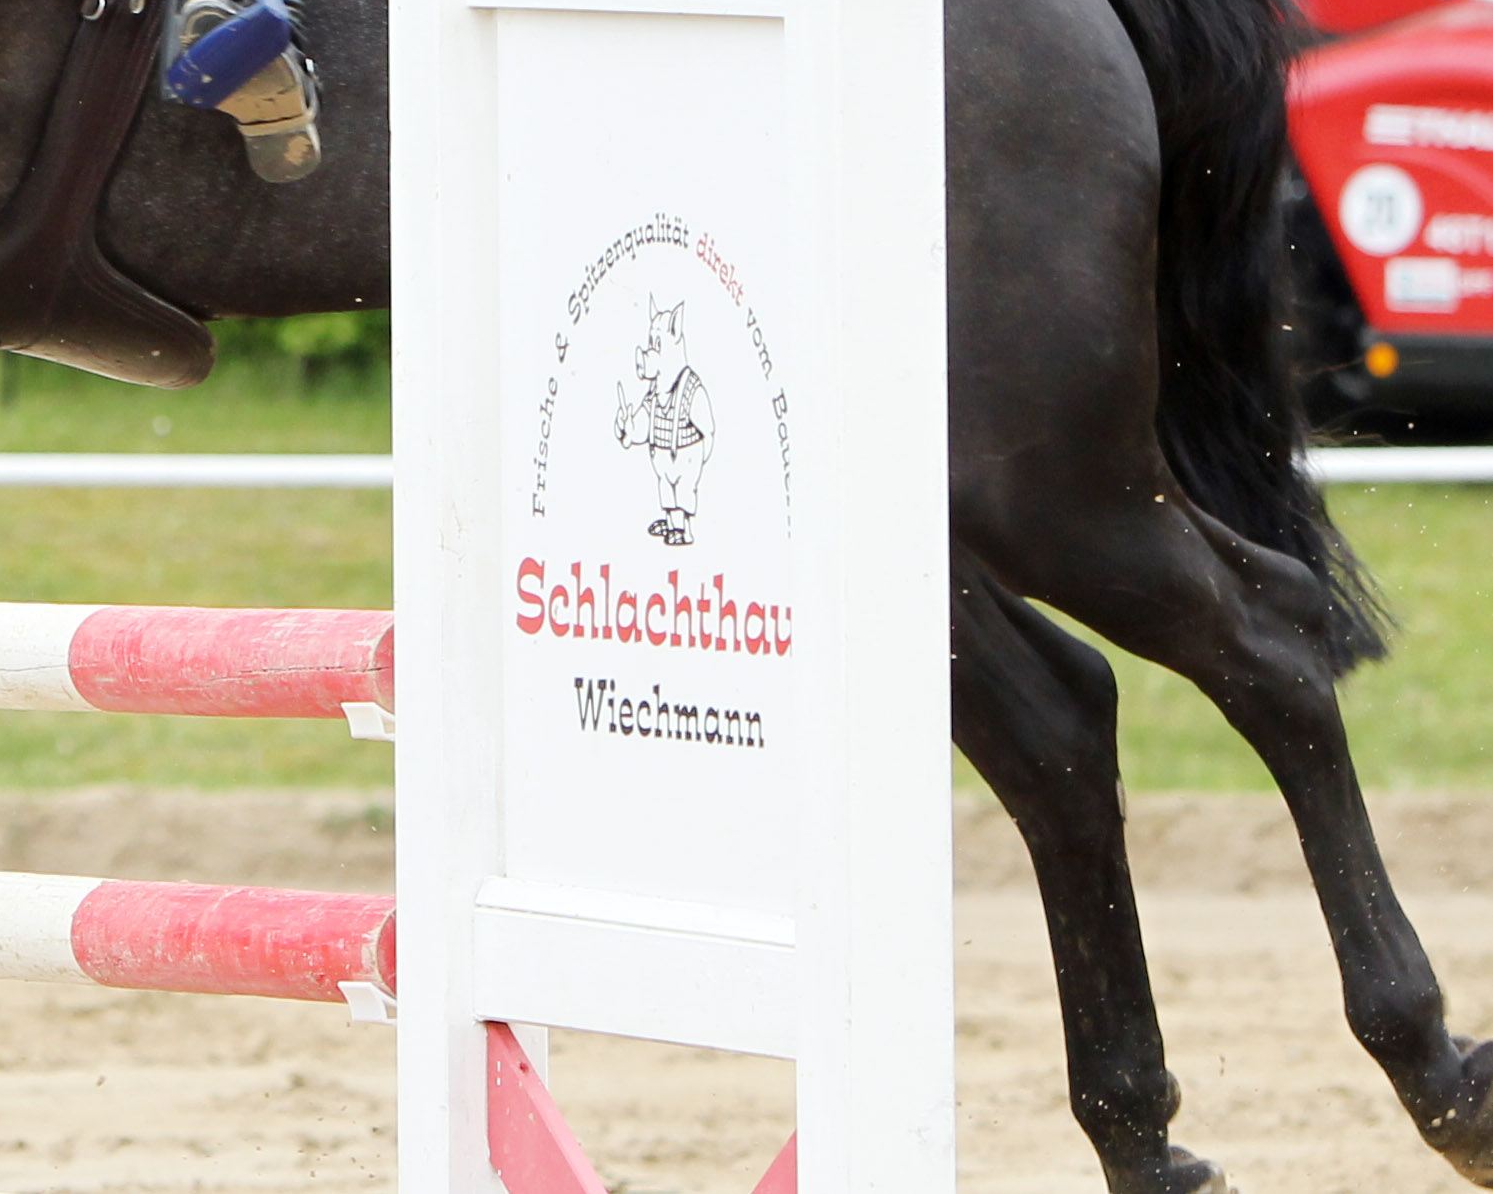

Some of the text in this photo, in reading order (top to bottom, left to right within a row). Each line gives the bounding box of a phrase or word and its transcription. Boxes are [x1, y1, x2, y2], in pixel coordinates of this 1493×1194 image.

[532, 377, 558, 517] Frische
[556, 332, 570, 363] &
[568, 213, 690, 325] Spitzenqualität
[696, 232, 744, 307] direkt
[746, 307, 773, 380] vom
[573, 677, 765, 749] Wiechmann
